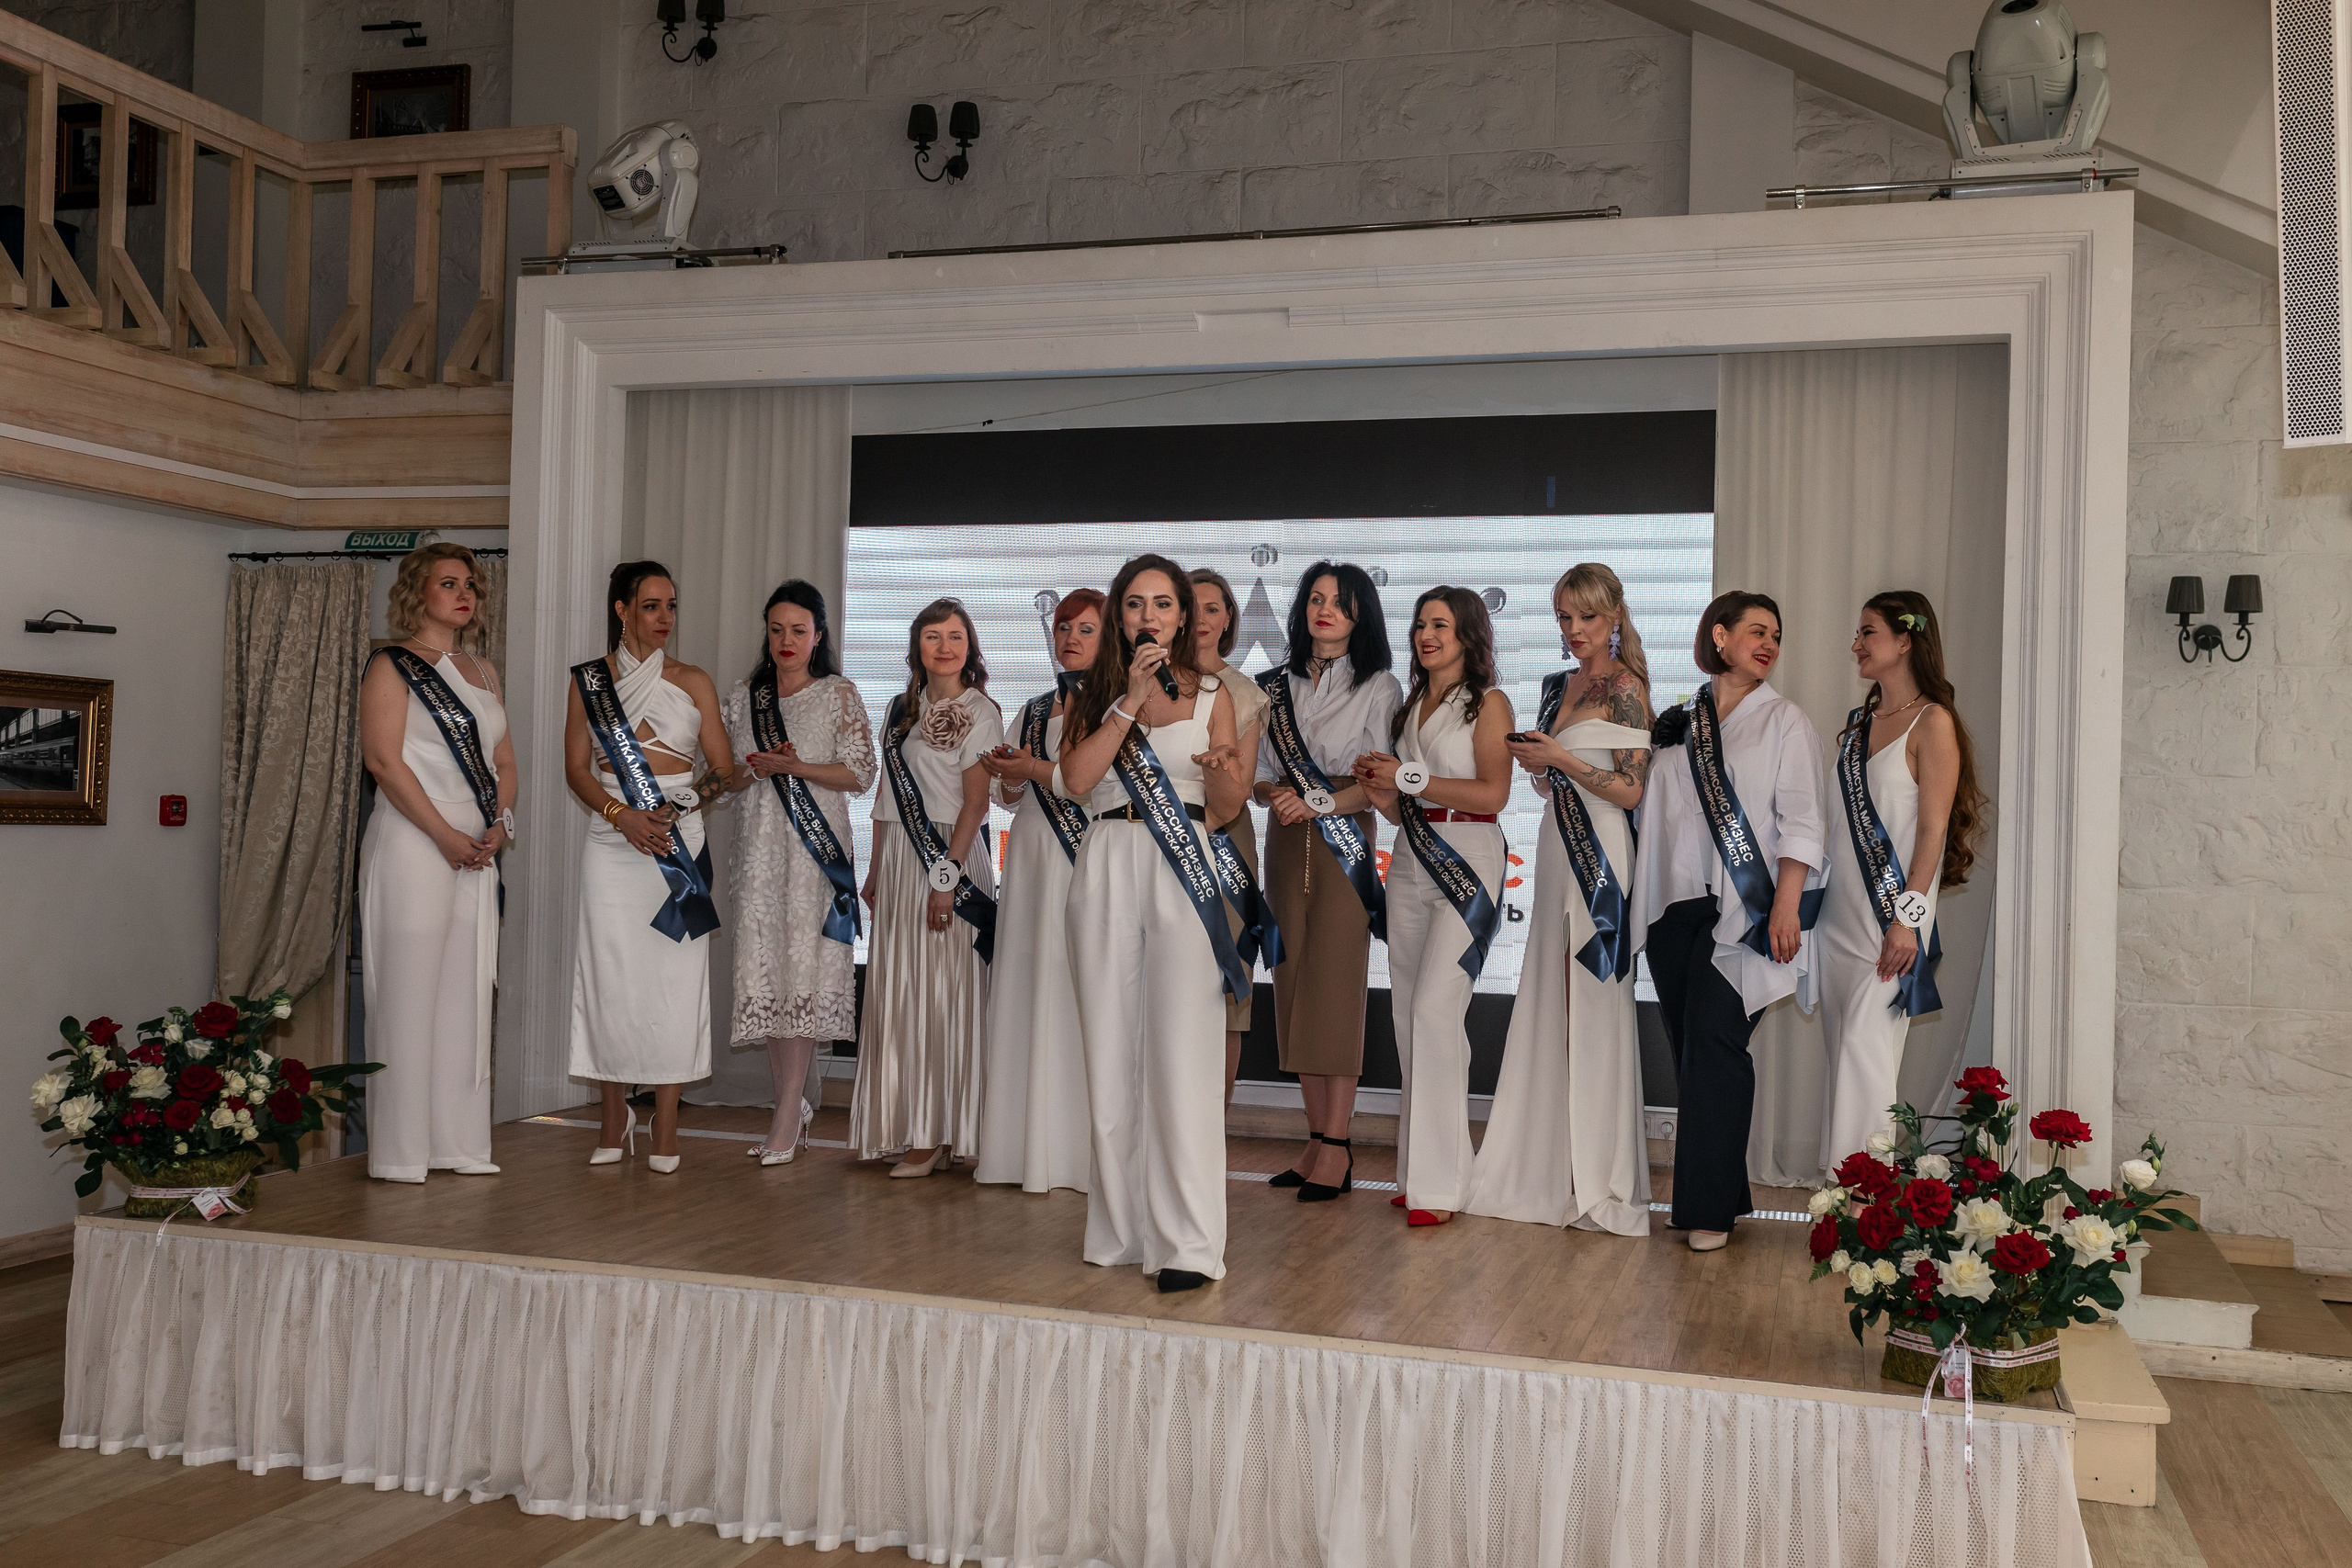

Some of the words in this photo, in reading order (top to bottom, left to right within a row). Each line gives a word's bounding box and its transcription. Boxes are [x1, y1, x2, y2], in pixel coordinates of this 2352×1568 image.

[350, 533, 412, 547] ВЫХОД
[420, 682, 461, 741] НОВОСИБИРСК
[429, 680, 476, 755] ФИНАЛИСТКА
[472, 752, 495, 799] МИССИС
[757, 713, 771, 751] НОВОСИБИР
[766, 708, 782, 750] ФИНАЛИ
[590, 695, 616, 750] НОВОСИБИРСК
[616, 754, 647, 811] НОВОСИБИРС
[600, 691, 637, 764] ФИНАЛИСТКА
[629, 762, 660, 812] МИССИС
[890, 748, 920, 820] ФИНАЛИСТКА
[1271, 709, 1290, 763] НОВОСИБИРСК
[1331, 826, 1355, 867] ОБЛАСТЬ
[1277, 705, 1310, 776] ФИНАЛИСТКА
[1336, 817, 1366, 862] БИЗНЕС
[1699, 702, 1714, 761] ФИНАЛИСТКА
[1707, 760, 1731, 814] МИССИС
[1724, 812, 1754, 863] БИЗНЕС
[506, 815, 513, 832] 2
[674, 792, 693, 802] 3
[888, 752, 908, 807] НОВОСИБИРСК
[905, 813, 933, 870] НОВОСИБИРСК
[1312, 795, 1329, 807] 8
[1696, 755, 1724, 826] НОВОСИБИРСКАЯ
[1718, 825, 1741, 867] ОБЛАСТЬ
[1850, 731, 1865, 810] ФИНАЛИСТКА
[1860, 809, 1888, 865] МИССИС
[808, 830, 830, 866] ОБЛАСТЬ
[810, 819, 839, 861] БИЗНЕС
[1133, 777, 1184, 859] НОВОСИБИРСКАЯ
[1180, 857, 1205, 903] ОБЛАСТЬ
[1152, 785, 1191, 844] МИССИС
[1184, 843, 1215, 898] БИЗНЕС
[1218, 846, 1250, 889] БИЗНЕС
[1411, 817, 1447, 860] МИССИС
[1443, 857, 1477, 897] БИЗНЕС
[1555, 782, 1580, 852] НОВОСИБИРСКАЯ
[1576, 852, 1595, 892] ОБЛАСТЬ
[1565, 788, 1587, 840] МИССИС
[1580, 840, 1608, 888] БИЗНЕС
[1850, 802, 1879, 878] НОВОСИБИРСКАЯ
[1872, 877, 1893, 919] ОБЛАСТЬ
[938, 866, 950, 885] 5
[1216, 858, 1239, 896] ОБЛАСТЬ
[1441, 872, 1465, 902] ОБЛАСТЬ
[1898, 894, 1927, 924] 13
